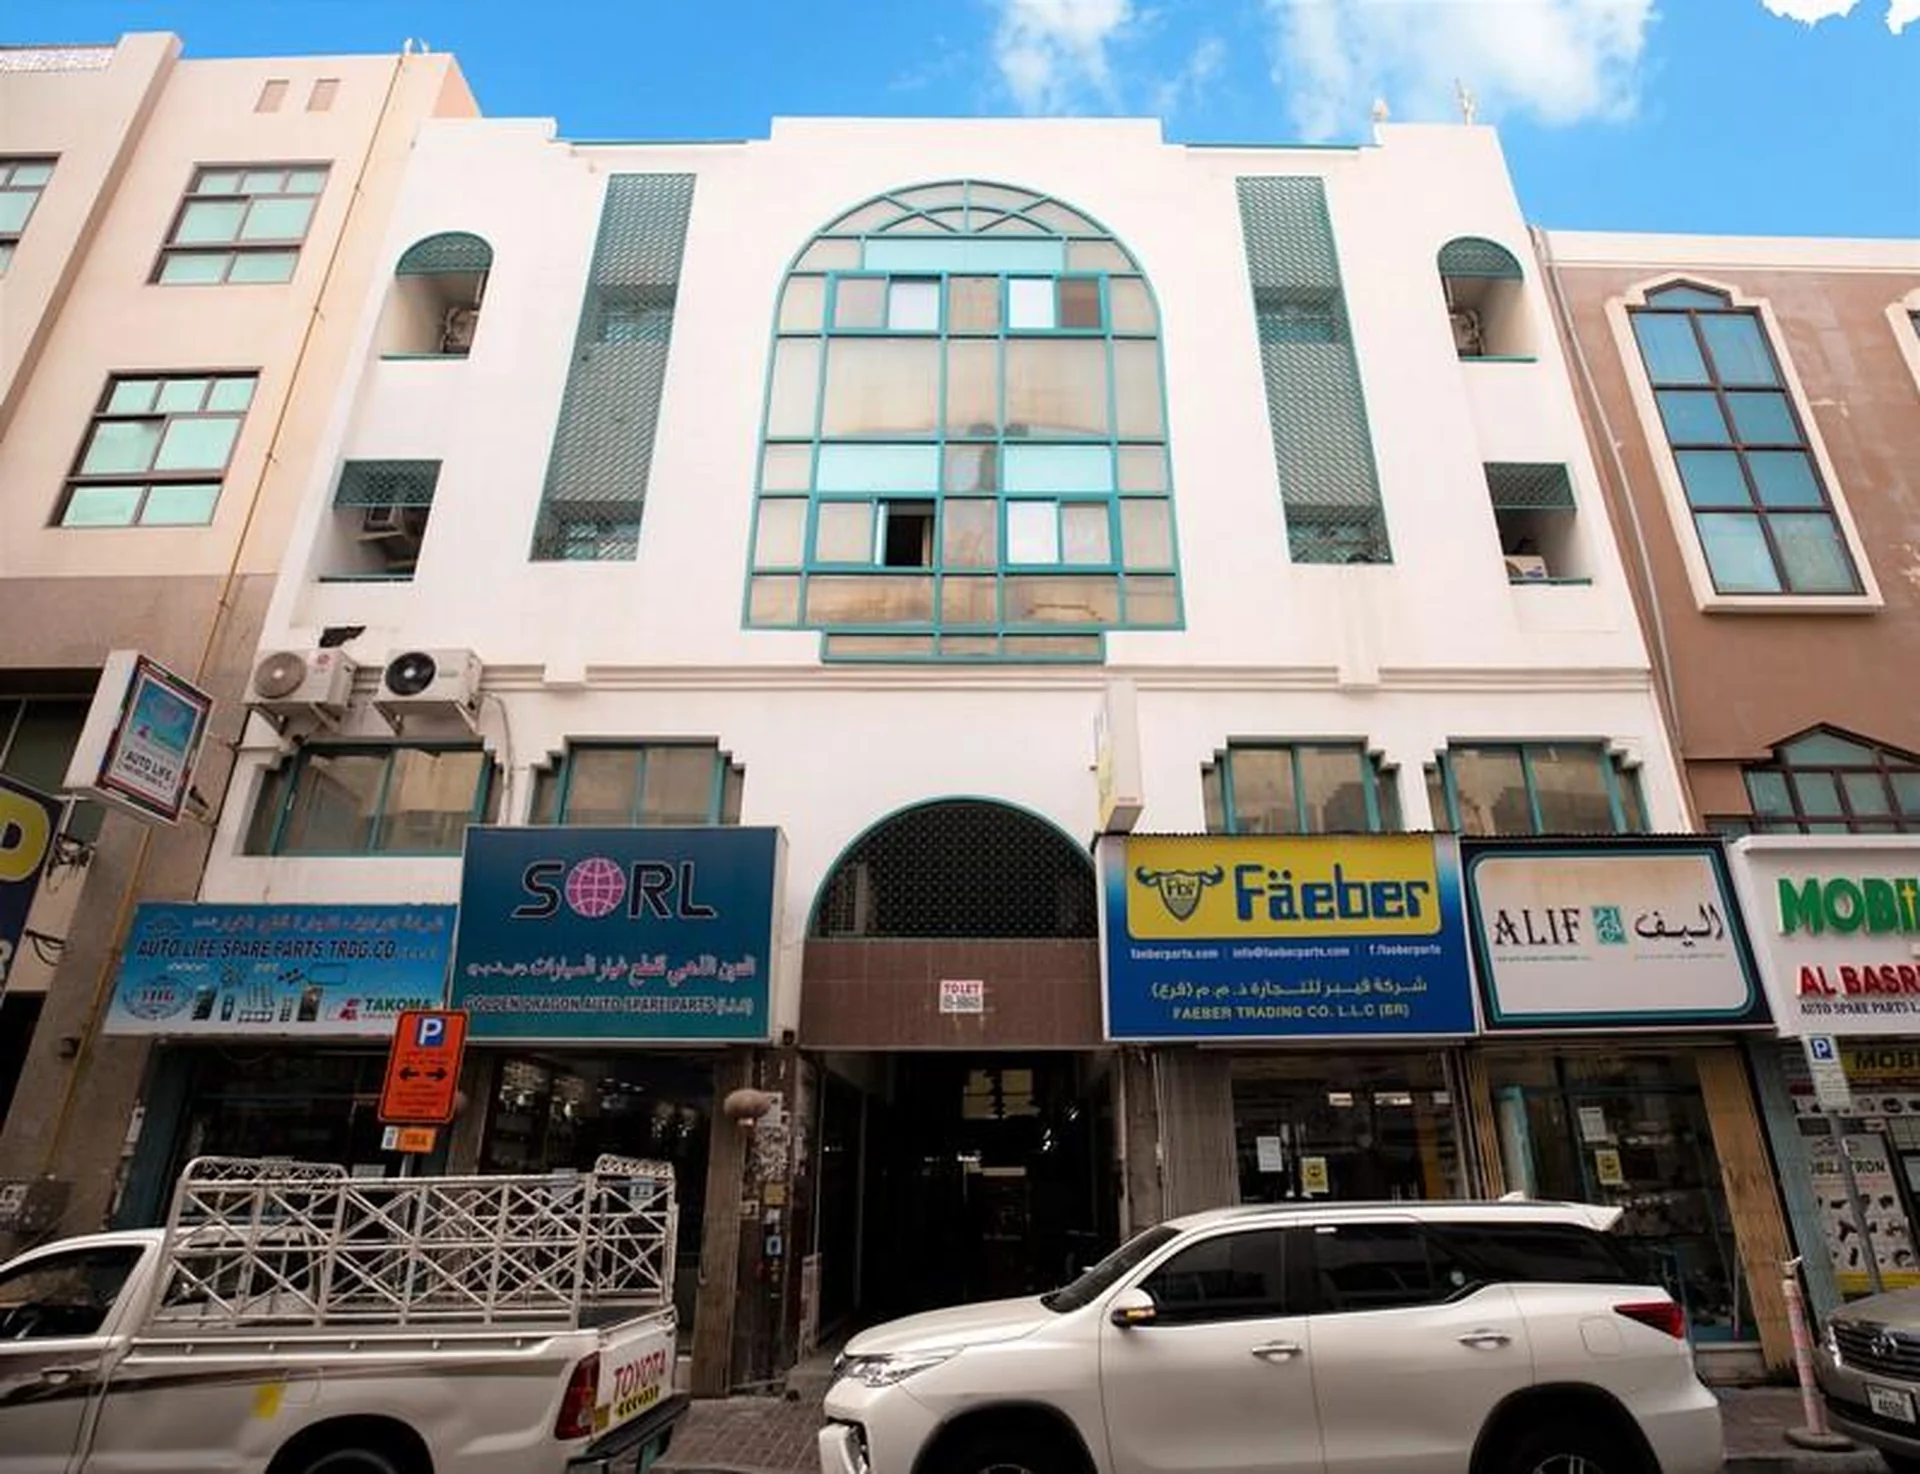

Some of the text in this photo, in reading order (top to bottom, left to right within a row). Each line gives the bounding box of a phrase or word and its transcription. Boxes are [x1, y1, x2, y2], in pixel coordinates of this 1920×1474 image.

[511, 857, 718, 919] SORL
[1235, 863, 1429, 921] Fäeber
[1494, 907, 1580, 946] ALIF
[137, 940, 177, 958] AUTO
[181, 940, 215, 958] LIFE
[221, 940, 271, 958] SPARE
[274, 940, 323, 958] PARTS
[1800, 964, 1920, 996] AL BASR
[1173, 1006, 1231, 1020] FAEBER
[1236, 1005, 1303, 1019] TRADING
[1801, 1002, 1832, 1014] AUTO
[614, 1348, 665, 1404] TOYOTA
